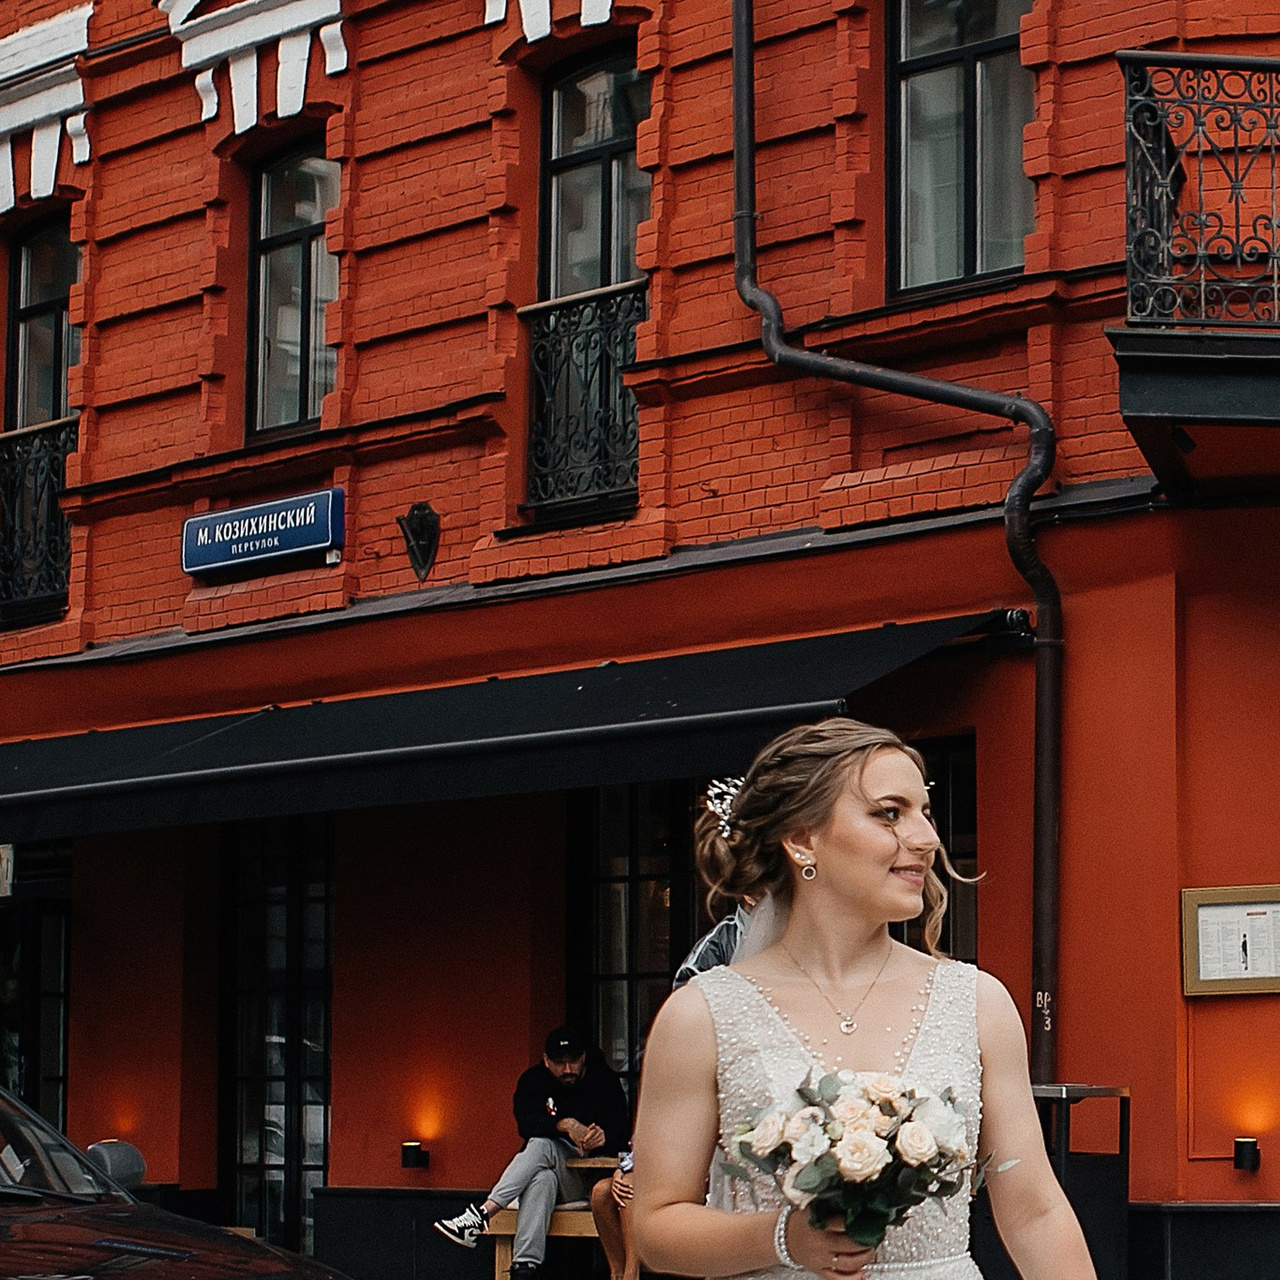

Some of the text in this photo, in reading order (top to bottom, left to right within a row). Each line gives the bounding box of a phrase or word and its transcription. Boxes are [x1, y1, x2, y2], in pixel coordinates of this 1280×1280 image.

[197, 502, 316, 546] М. КОЗИХИНСКИЙ
[231, 536, 279, 554] ПЕРЕУЛОК
